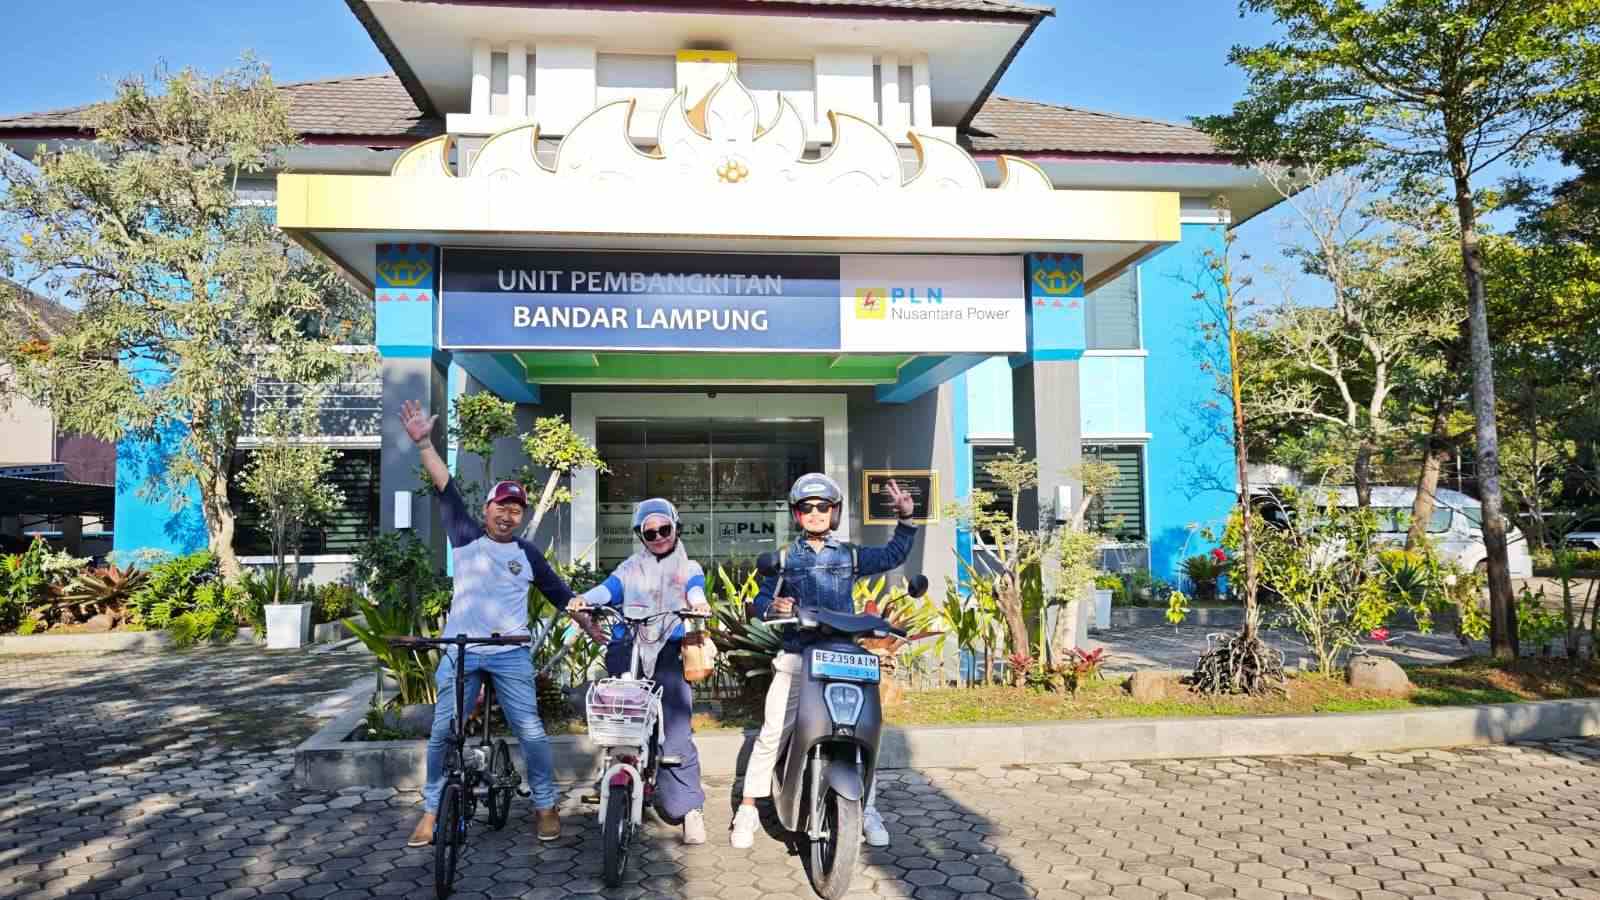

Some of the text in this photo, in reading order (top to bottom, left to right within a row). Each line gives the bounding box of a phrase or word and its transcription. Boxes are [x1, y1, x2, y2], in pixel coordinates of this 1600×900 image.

[498, 270, 783, 295] UNIT PEMBANGKITAN
[891, 287, 944, 304] PLN
[513, 306, 769, 331] BANDAR LAMPUNG
[891, 307, 1010, 321] Nusantara Power
[737, 522, 775, 534] PLN
